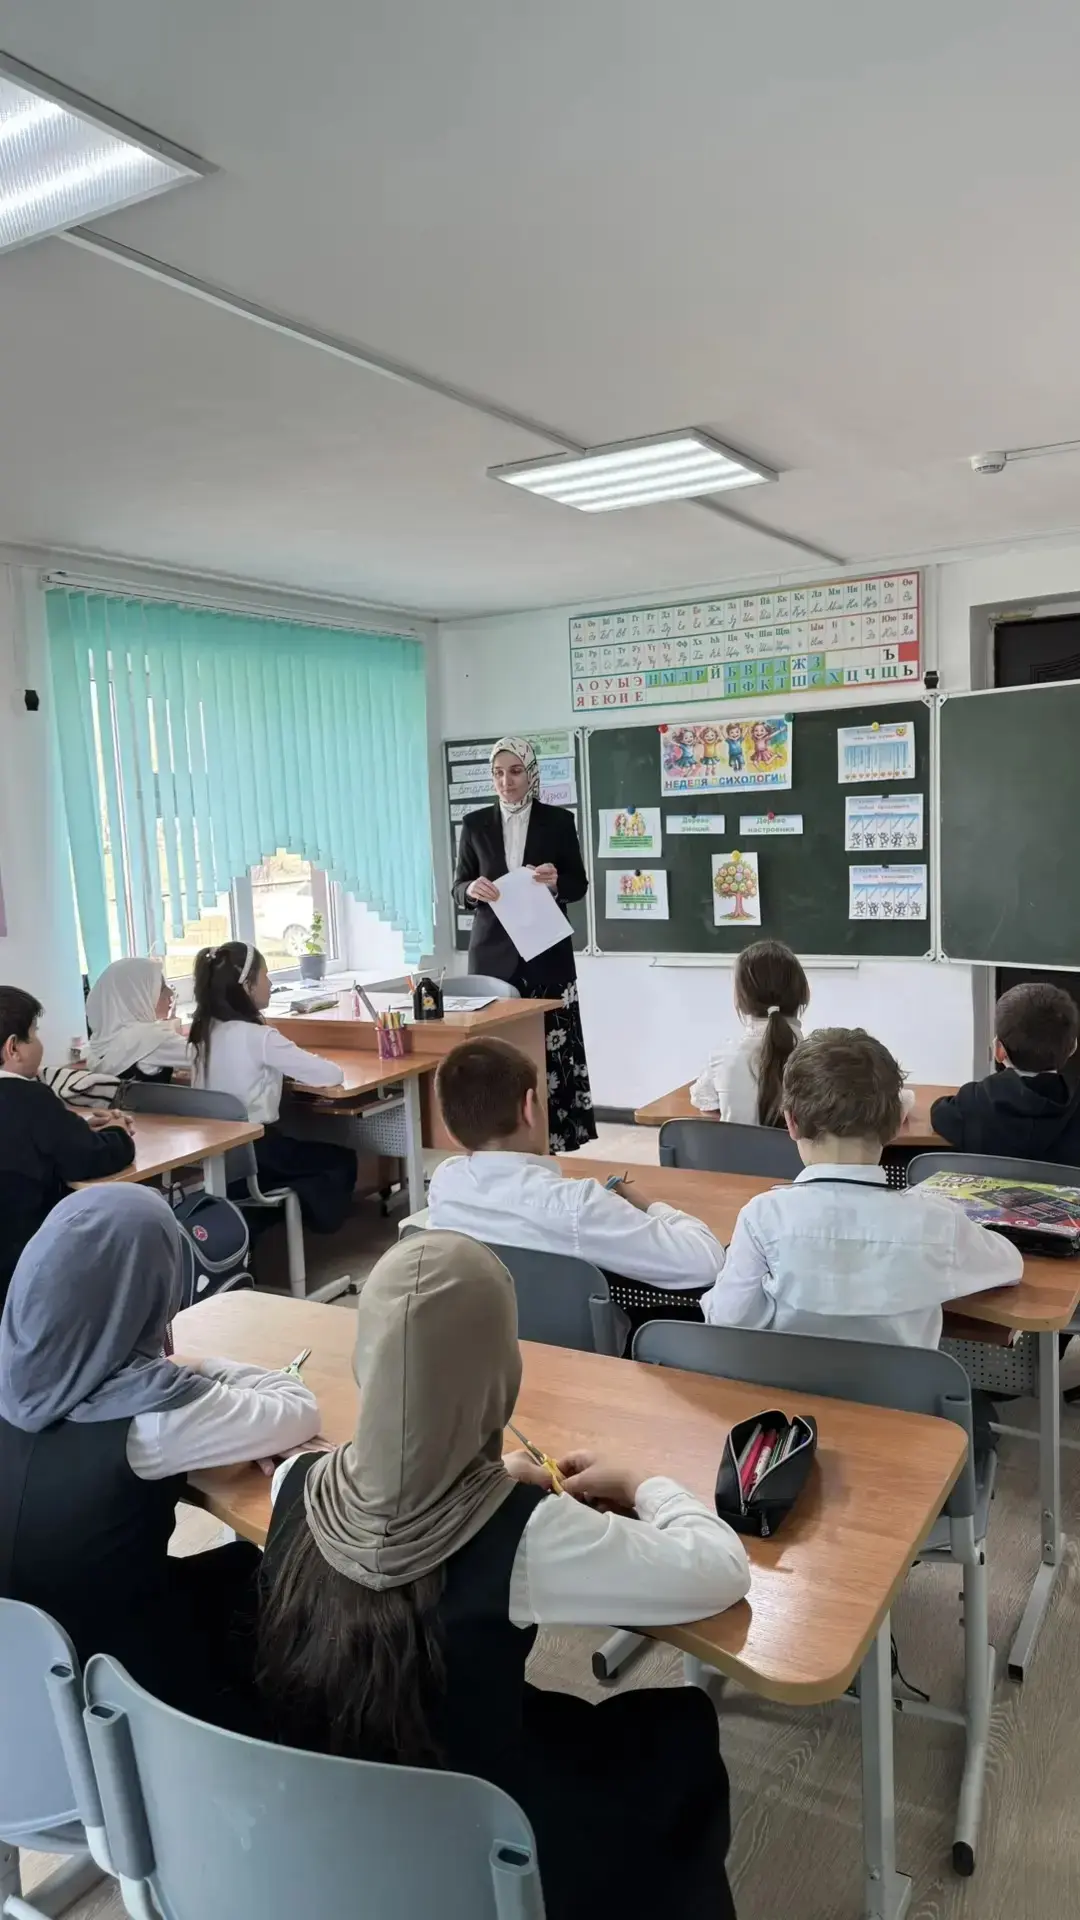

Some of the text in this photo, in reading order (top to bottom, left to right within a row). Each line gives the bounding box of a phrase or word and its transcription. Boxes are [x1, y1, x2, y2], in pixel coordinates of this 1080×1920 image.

[576, 683, 584, 692] А
[589, 680, 599, 690] О
[604, 679, 613, 689] У
[618, 678, 629, 688] Ы
[634, 676, 642, 686] Э
[711, 665, 720, 679] Й
[745, 664, 753, 675] В
[791, 658, 806, 670] Ж
[883, 649, 895, 661] Ъ
[577, 697, 585, 707] Я
[603, 694, 616, 705] Ю
[727, 683, 737, 693] П
[742, 682, 754, 691] Ф
[761, 679, 770, 690] К
[792, 675, 806, 687] Ш
[847, 670, 859, 682] Ц
[865, 668, 875, 679] Ч
[881, 666, 898, 678] Щ
[903, 665, 913, 676] Ь
[665, 773, 786, 790] НЕДЕЛЯ ПСИХОЛОГИИ
